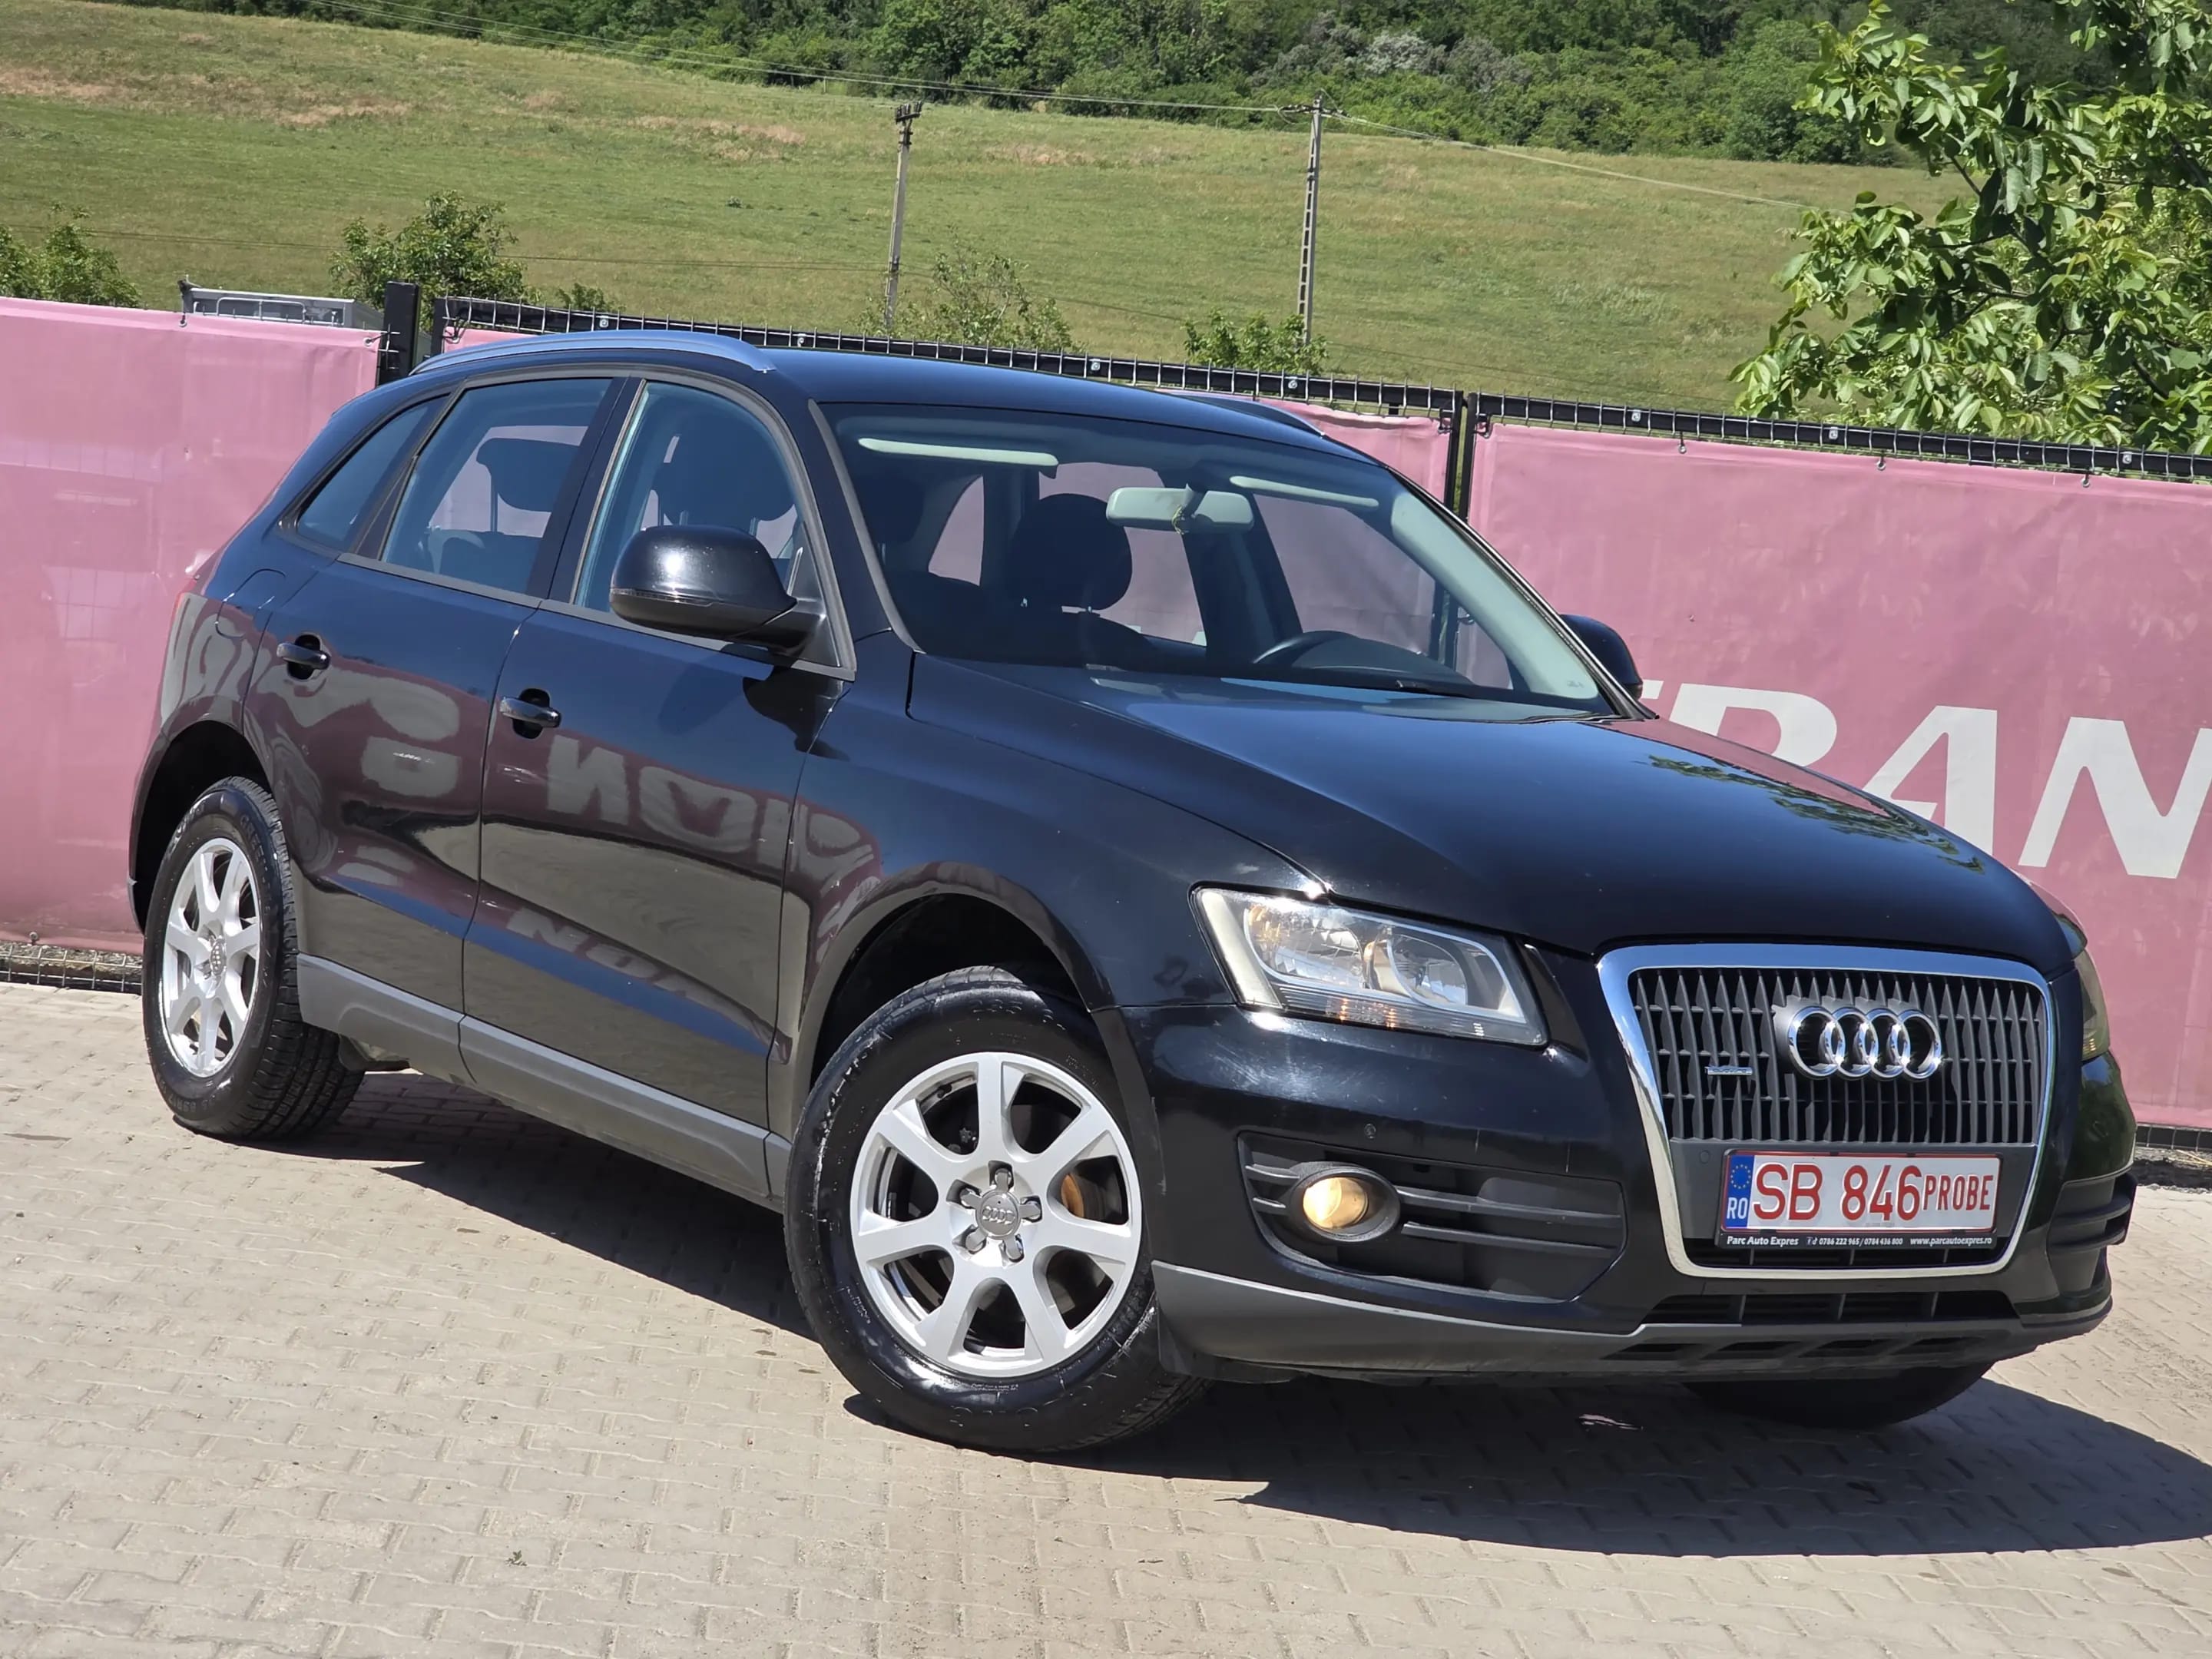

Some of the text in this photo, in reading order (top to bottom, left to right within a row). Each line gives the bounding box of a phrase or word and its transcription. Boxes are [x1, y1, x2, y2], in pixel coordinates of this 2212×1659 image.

[1753, 1162, 1993, 1221] SB 846 PROBE
[1727, 1197, 1748, 1220] RO
[1727, 1236, 1746, 1245] Parc
[1747, 1237, 1769, 1245] Auto
[1770, 1237, 1799, 1247] Expres
[1910, 1237, 1992, 1247] www.parcautoexpres.ro
